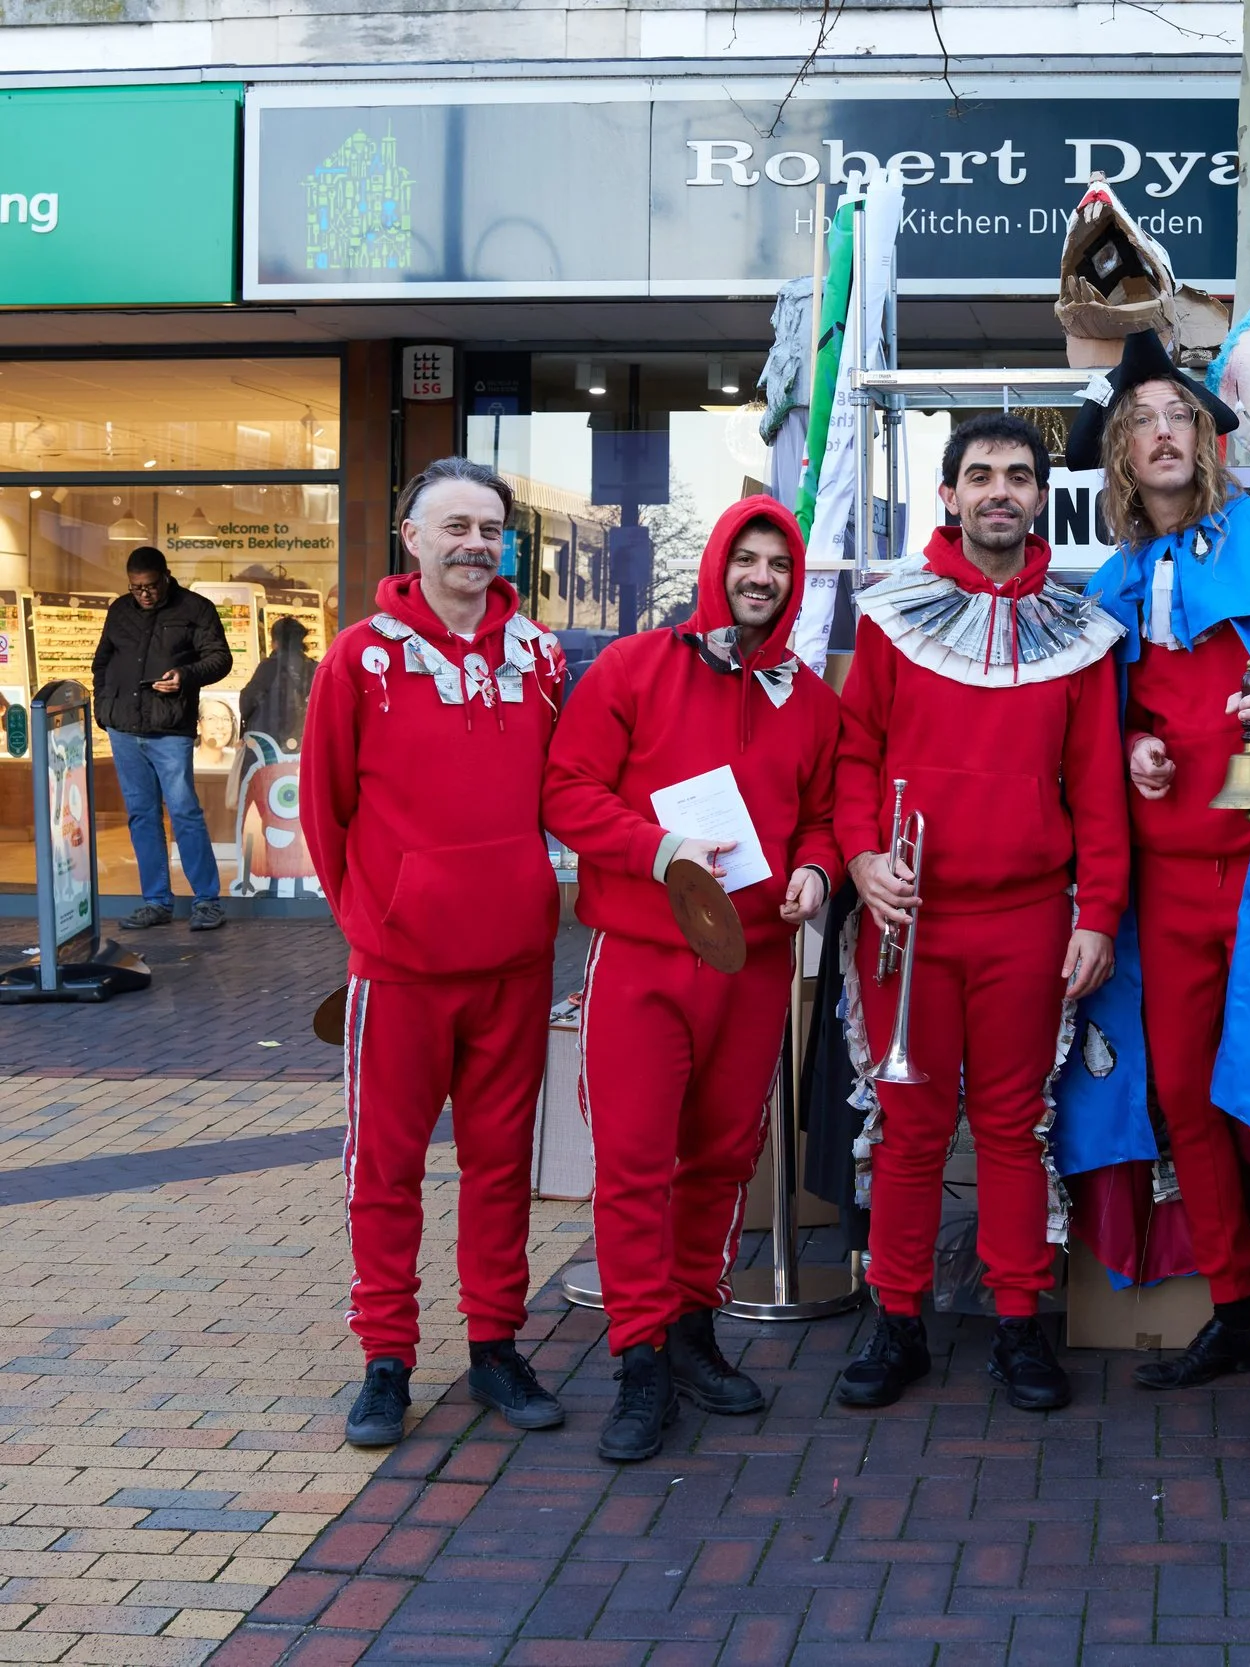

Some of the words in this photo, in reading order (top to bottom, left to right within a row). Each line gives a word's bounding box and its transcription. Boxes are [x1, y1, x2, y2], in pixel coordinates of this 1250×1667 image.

[686, 139, 1027, 187] Robert
[1064, 138, 1240, 198] Dya
[900, 207, 1009, 235] Kitchen
[1137, 207, 1203, 235] rden
[413, 383, 442, 395] LSG
[274, 523, 289, 534] to
[167, 537, 244, 551] Specsavers
[248, 536, 335, 551] Bexleyheath
